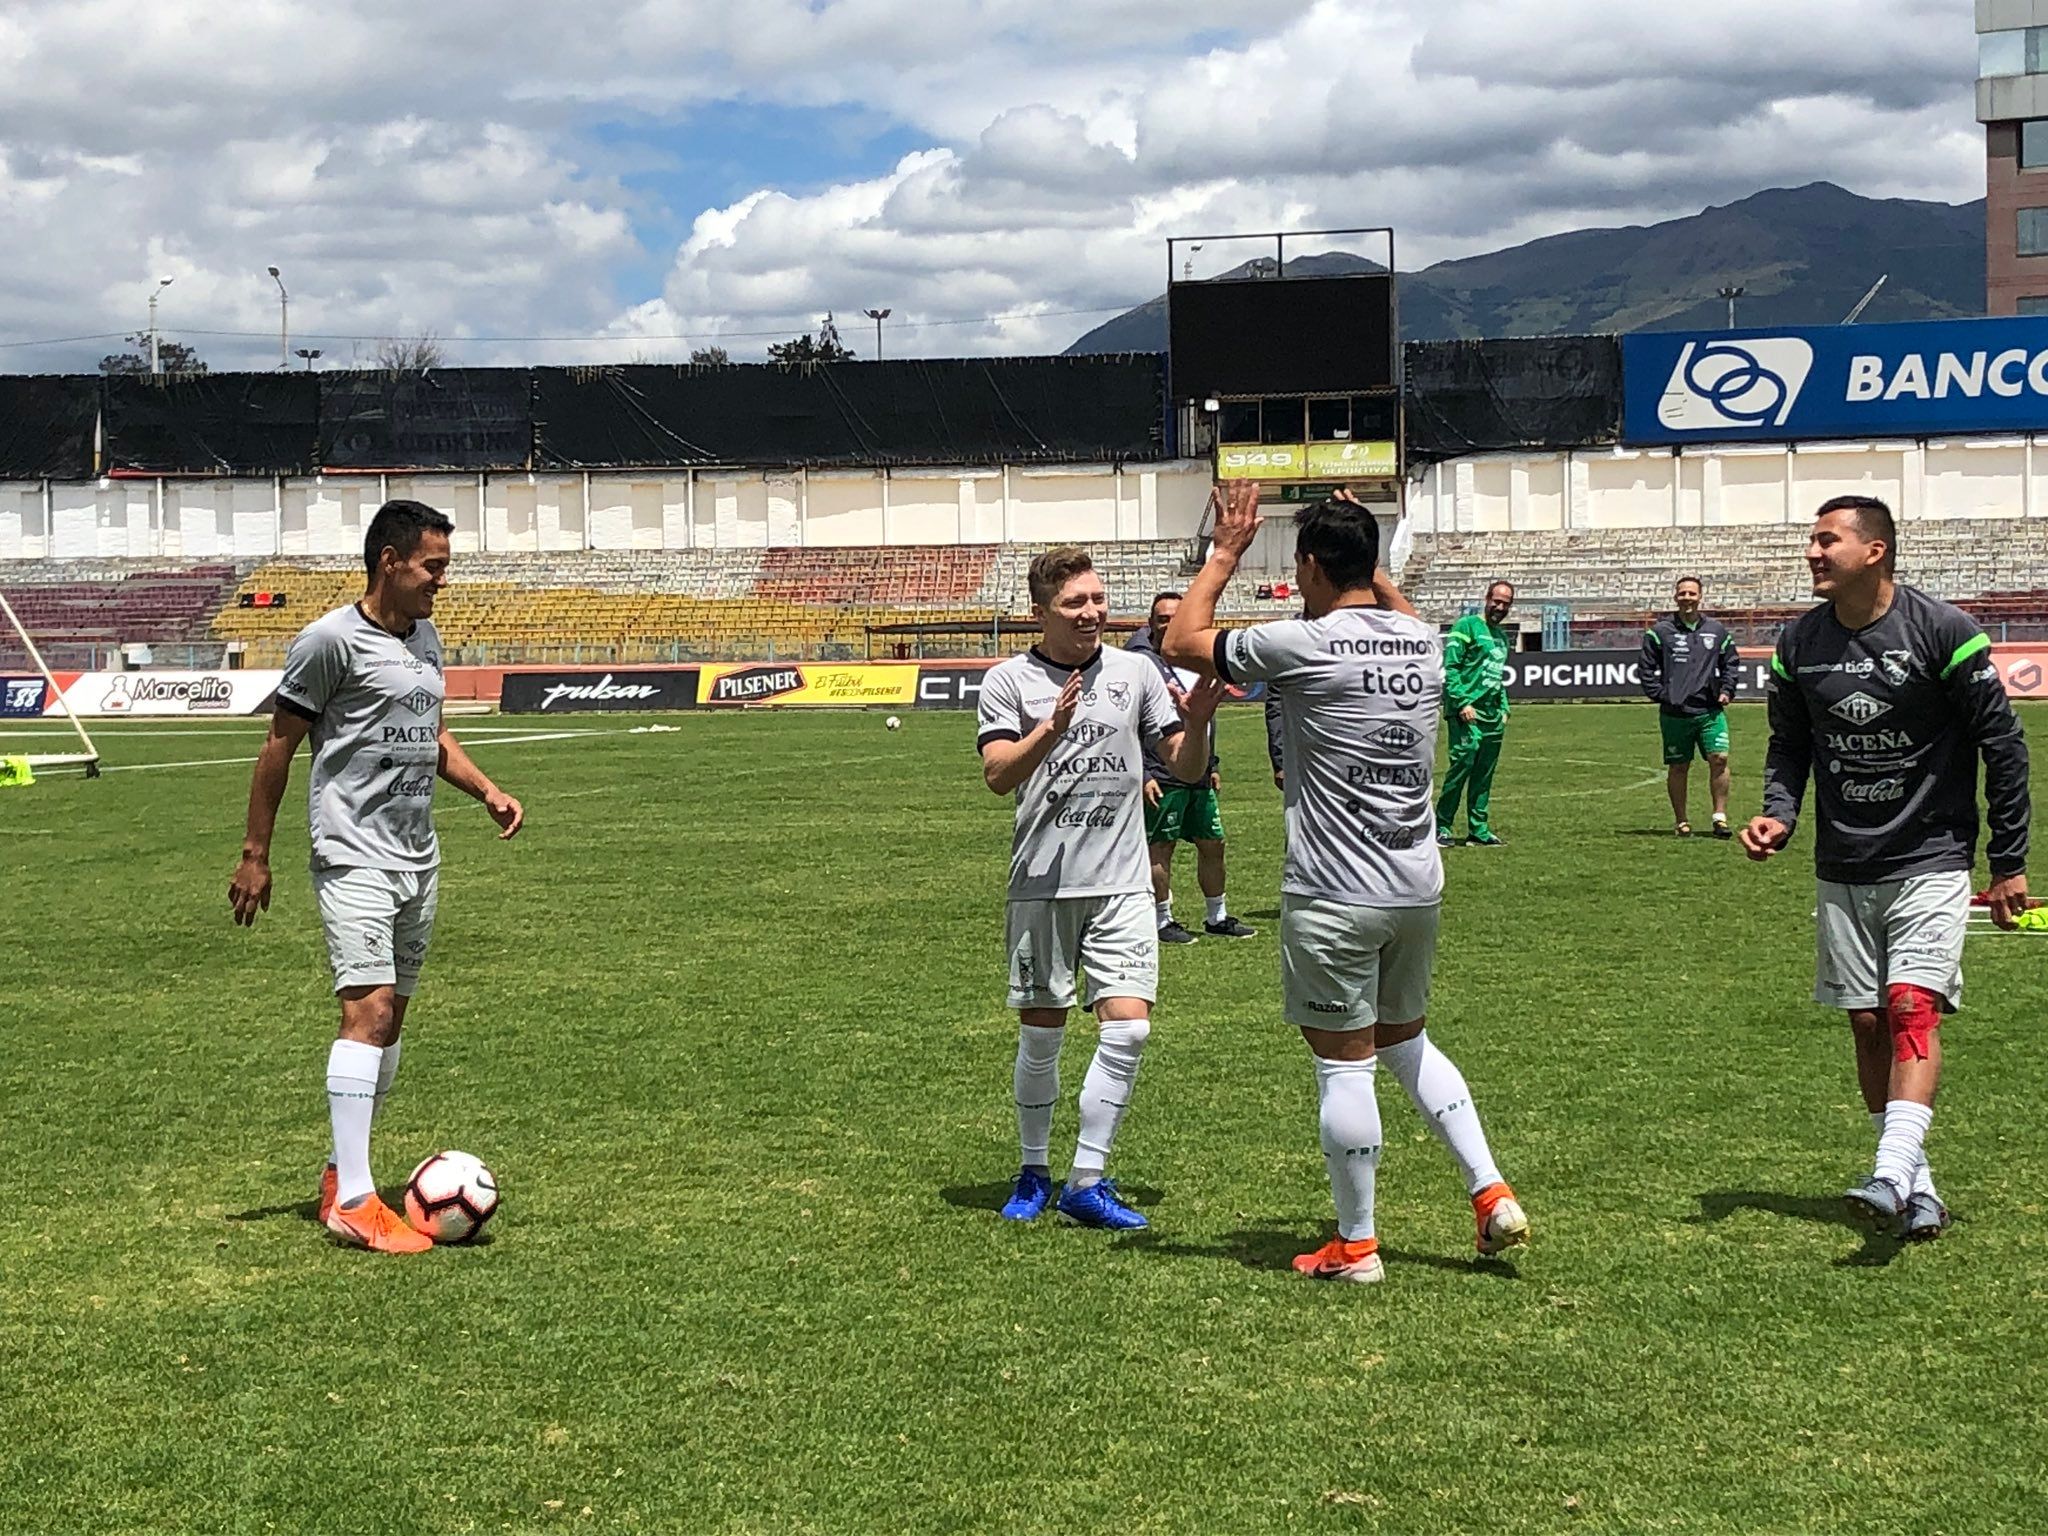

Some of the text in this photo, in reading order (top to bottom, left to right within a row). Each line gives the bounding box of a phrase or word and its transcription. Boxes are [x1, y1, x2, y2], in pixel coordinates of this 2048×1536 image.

[1226, 453, 1291, 467] 949
[719, 671, 797, 698] PILSENER
[1524, 663, 1642, 686] PICHINC
[13, 688, 43, 708] 88
[133, 677, 233, 701] Marcelito
[541, 673, 662, 710] pulsar
[920, 677, 981, 699] CH
[1046, 752, 1128, 777] PACEÑA
